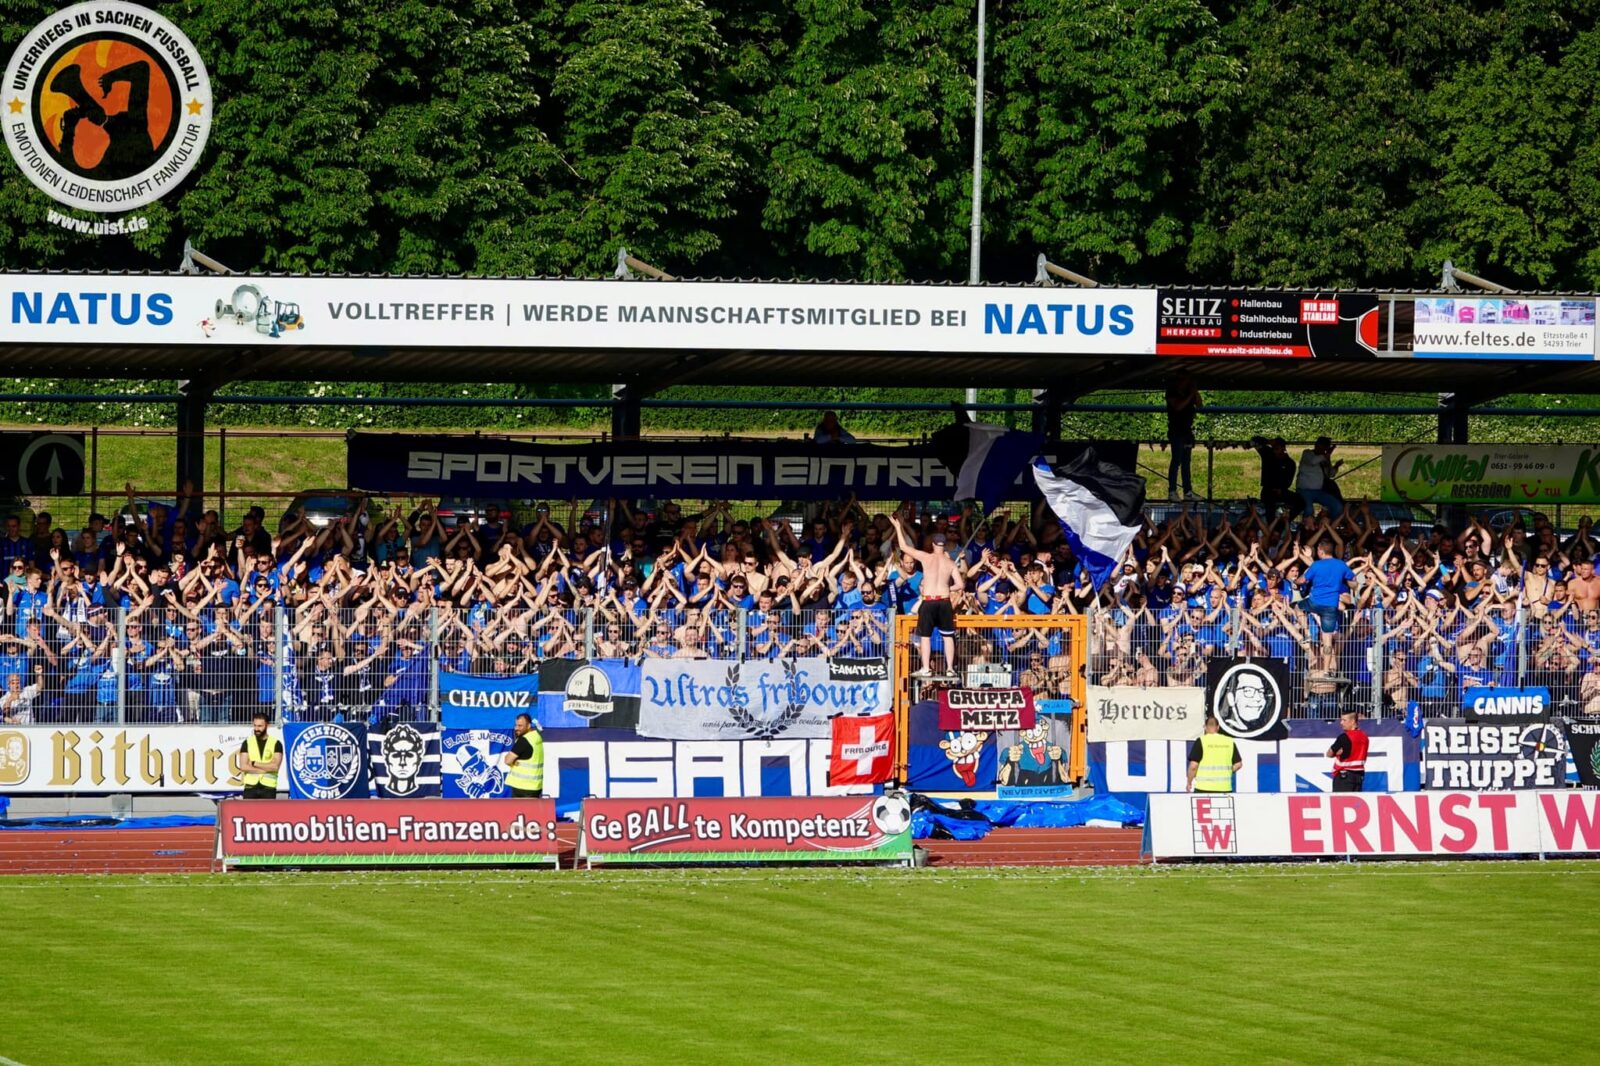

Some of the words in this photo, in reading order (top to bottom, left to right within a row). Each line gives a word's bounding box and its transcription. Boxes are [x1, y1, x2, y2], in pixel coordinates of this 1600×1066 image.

[1162, 297, 1222, 316] SEITZ
[1240, 300, 1282, 308] Hallenbau
[1303, 302, 1317, 312] WIR
[1319, 302, 1336, 312] SIND
[11, 292, 174, 325] NATUS
[328, 302, 495, 321] VOLLTREFFER
[523, 304, 609, 324] WERDE
[617, 305, 922, 327] MANNSCHAFTSMITGLIED
[931, 308, 967, 328] BEI
[984, 304, 1134, 336] NATUS
[1240, 315, 1298, 324] Stahlhochbau
[1303, 312, 1336, 321] STAHLBAU
[1166, 328, 1216, 336] HERFORST
[1240, 330, 1293, 339] Industriebau
[1414, 331, 1536, 347] www.feltes.de
[1208, 346, 1293, 355] www.seitz-stahlbau.de
[408, 451, 762, 486] SPORTVEREIN
[773, 456, 1056, 487] EINTRA
[1409, 453, 1490, 483] Kylltal
[1451, 483, 1513, 498] REISEBÜRO
[448, 689, 530, 708] CHAONZ
[645, 673, 748, 708] Ultras
[948, 690, 1026, 708] GRUPPA
[1099, 698, 1187, 724] Heredes
[1474, 695, 1544, 715] CANNIS
[961, 709, 1021, 729] METZ
[303, 726, 349, 742] SEKTION
[443, 733, 475, 749] BLAUE
[478, 732, 512, 748] JUGEND
[1427, 726, 1520, 754] REISE
[48, 730, 243, 786] Bitburg
[844, 743, 888, 754] FRIBOURG
[1427, 759, 1555, 787] TRUPPE
[232, 814, 540, 842] Immobilien-Franzen.de
[731, 813, 869, 844] Kompetenz
[1287, 794, 1517, 854] ERNST
